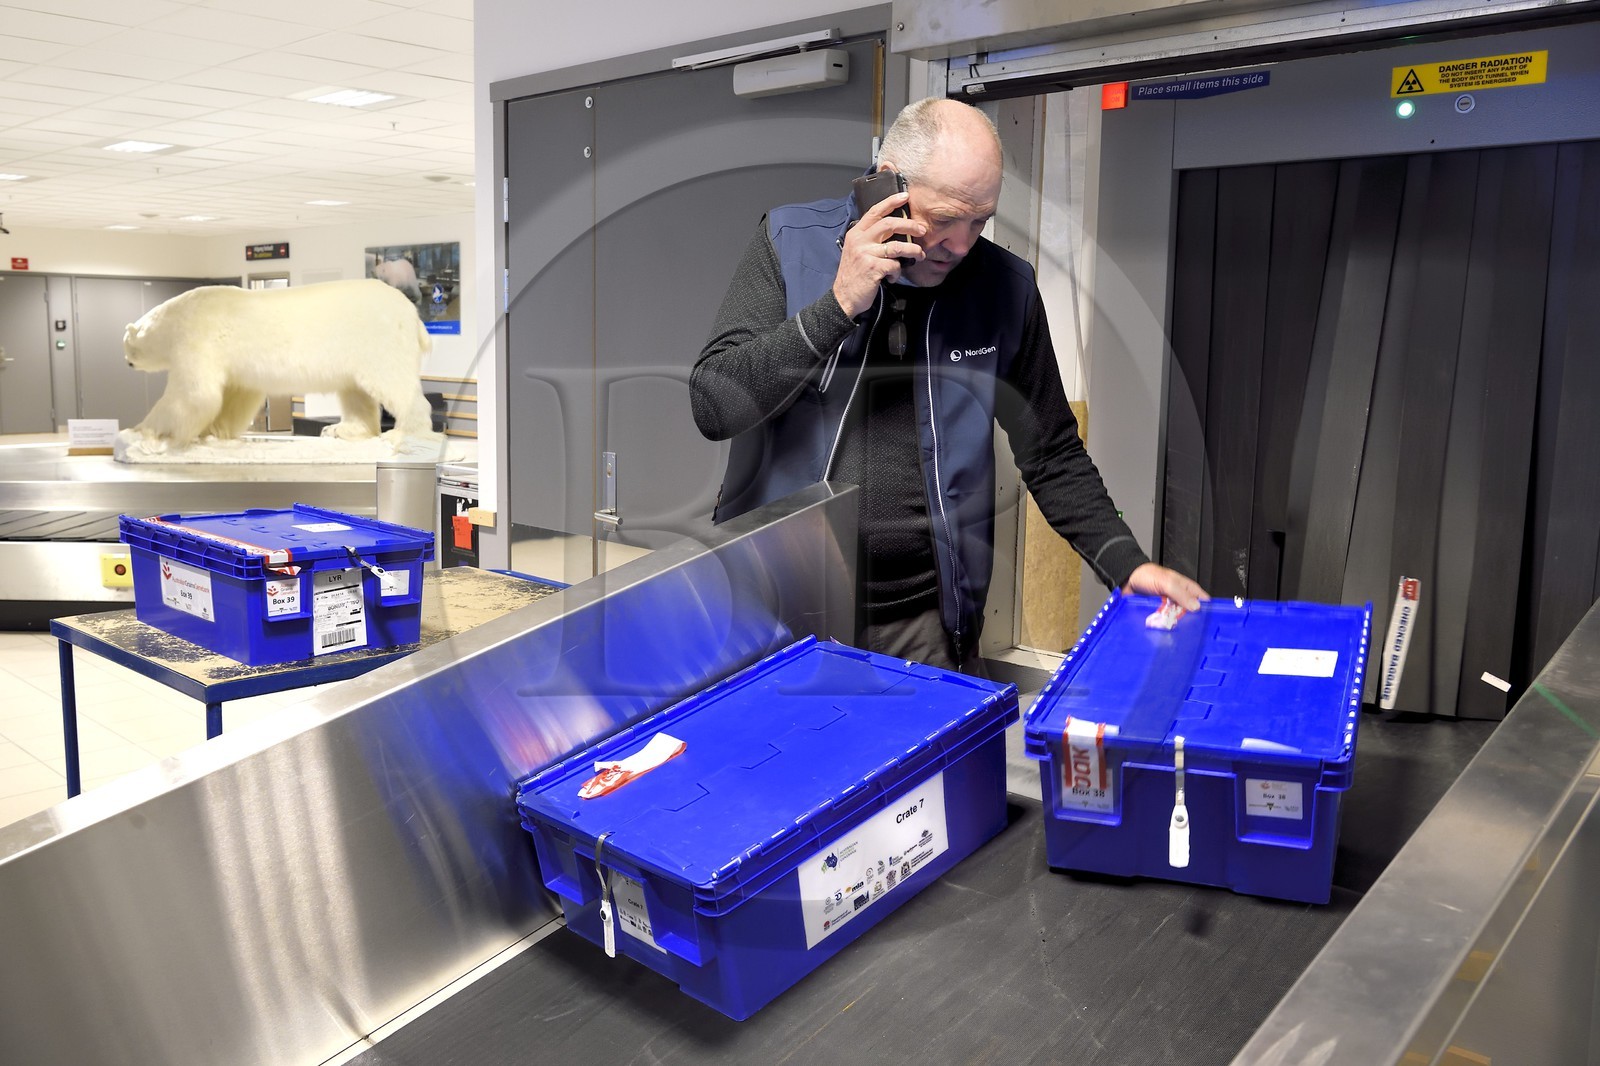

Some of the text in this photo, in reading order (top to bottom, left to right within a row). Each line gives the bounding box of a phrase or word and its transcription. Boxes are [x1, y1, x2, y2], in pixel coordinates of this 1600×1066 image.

[1438, 56, 1533, 73] DANGER RADIATION
[1138, 86, 1164, 96] Place
[1166, 81, 1191, 93] small
[1192, 79, 1220, 91] items
[1222, 76, 1240, 88] this
[1242, 74, 1264, 85] side
[1449, 81, 1474, 89] SYSTEM
[1481, 77, 1516, 86] ENERGISED
[964, 345, 997, 357] NordGen
[328, 574, 342, 583] LYR
[1394, 606, 1411, 652] CHECKED
[1383, 654, 1400, 701] BAGGAGE
[1072, 786, 1091, 796] Box
[895, 798, 925, 824] Crate 7
